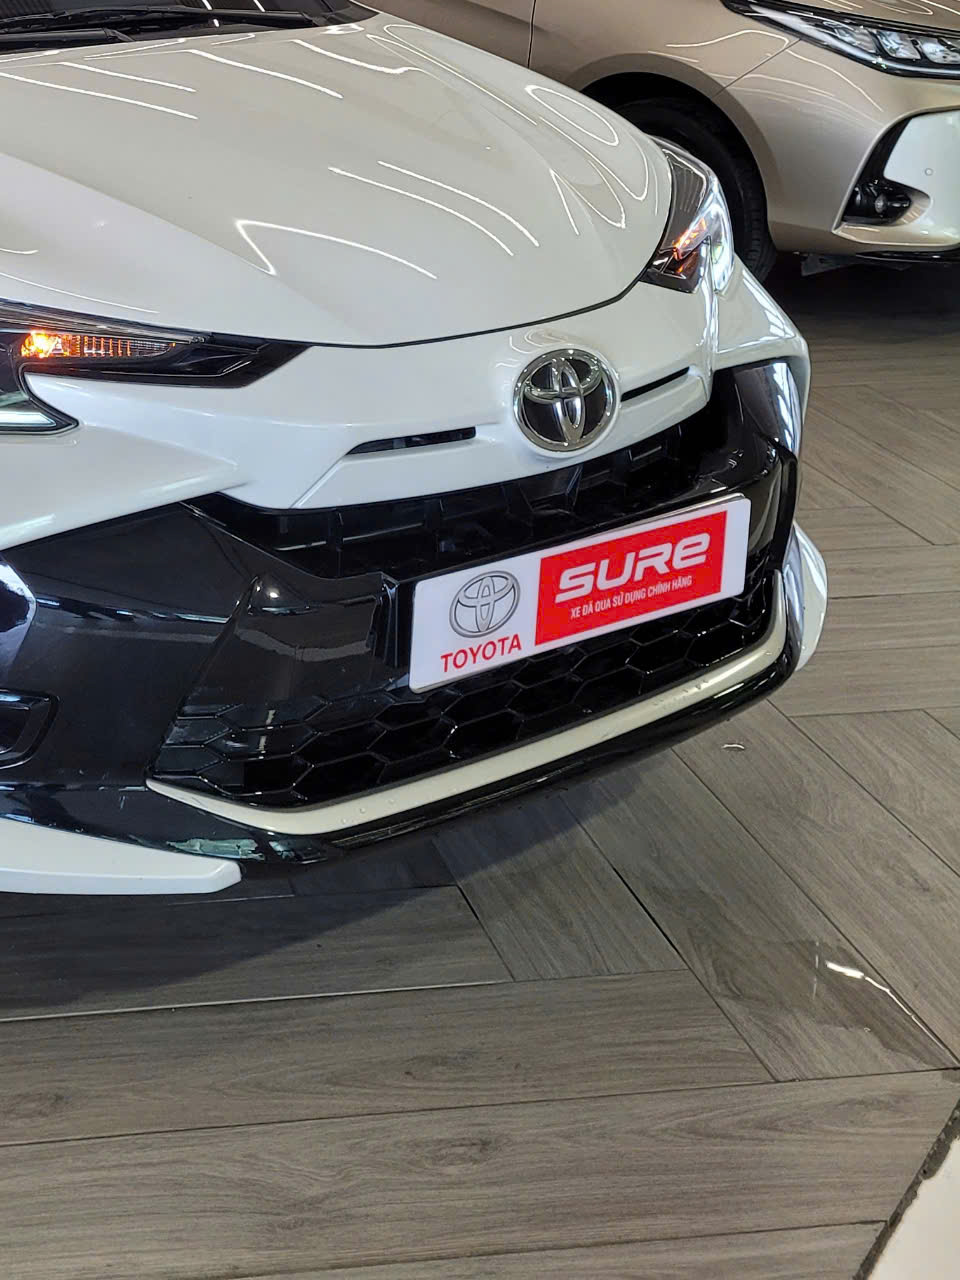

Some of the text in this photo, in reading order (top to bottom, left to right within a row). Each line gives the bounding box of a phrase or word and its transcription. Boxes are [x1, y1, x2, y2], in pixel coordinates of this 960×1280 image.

[570, 575, 693, 619] XE ĐÃ QUA SỬ DỤNG CHÍNH HÃNG
[440, 633, 522, 673] TOYOTA
